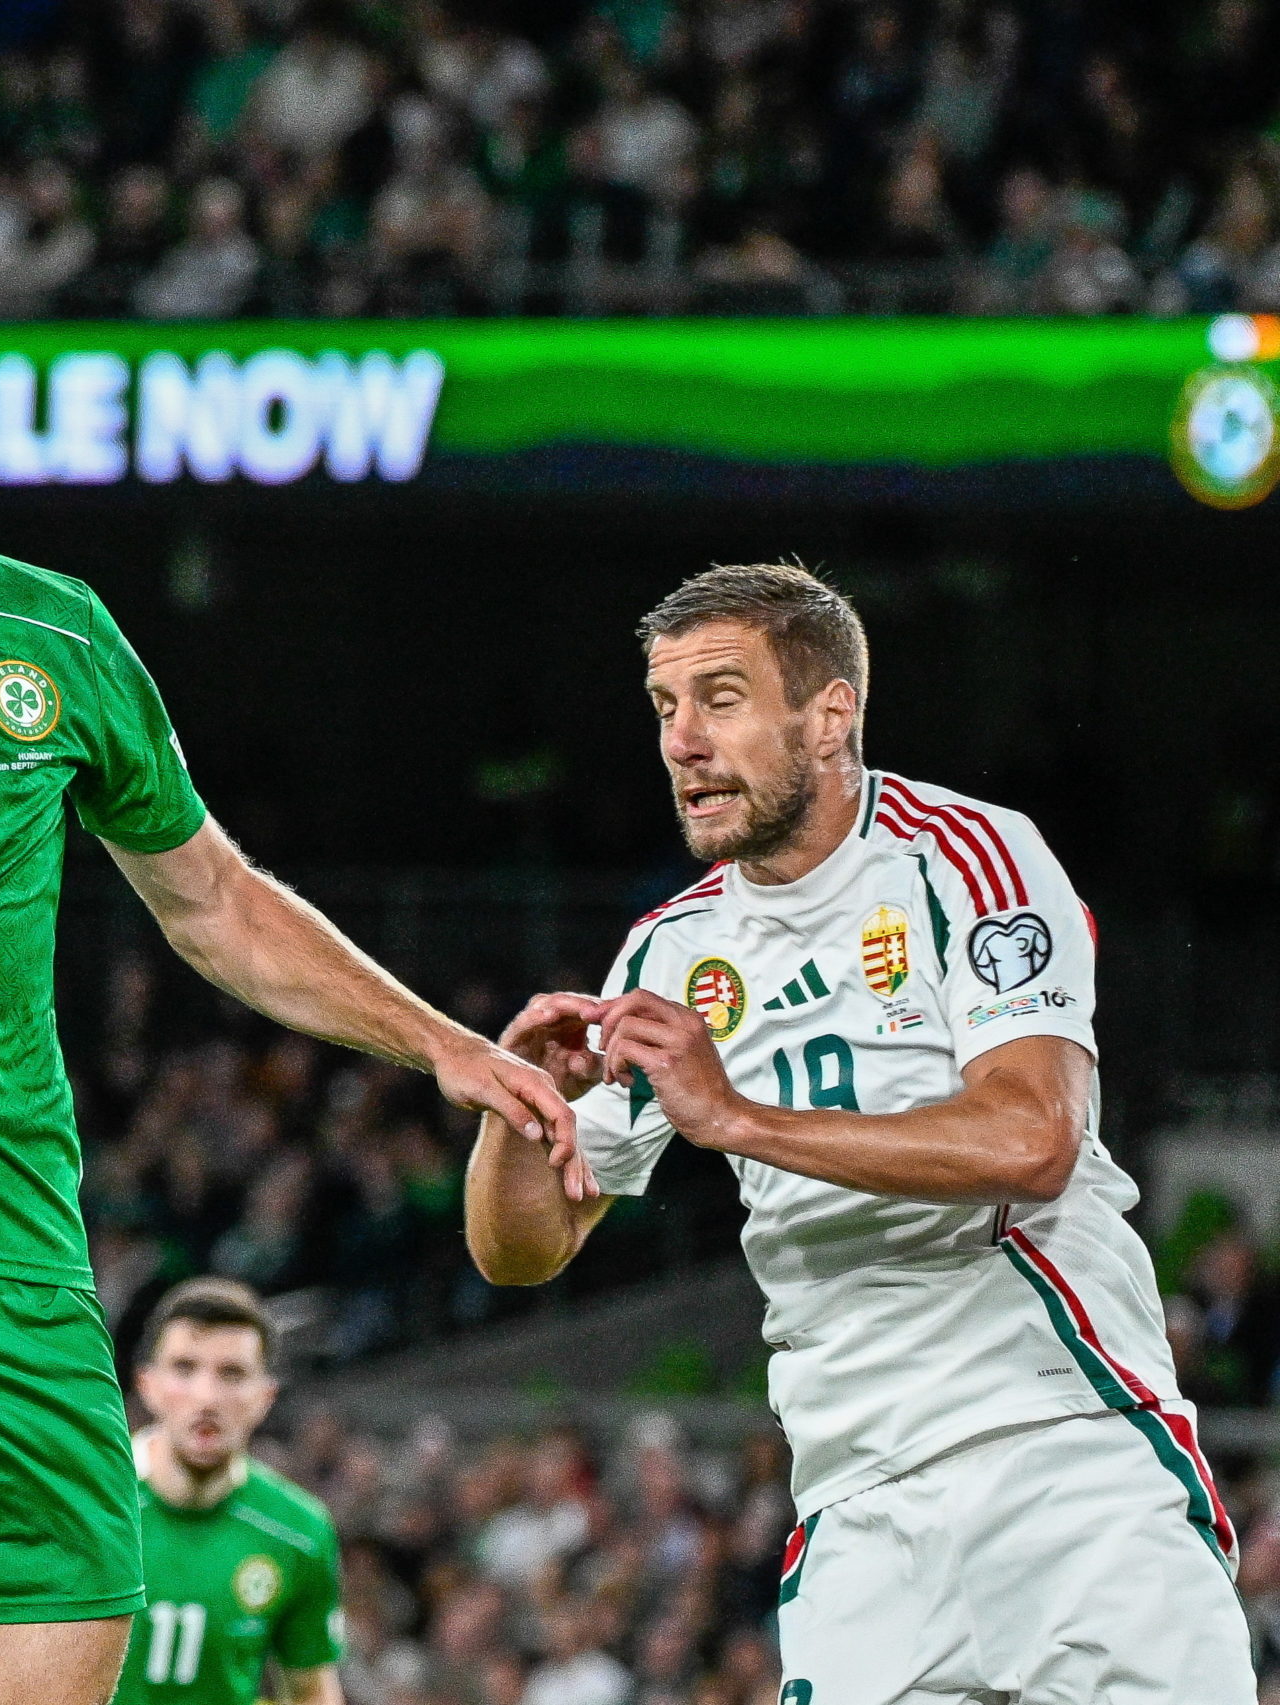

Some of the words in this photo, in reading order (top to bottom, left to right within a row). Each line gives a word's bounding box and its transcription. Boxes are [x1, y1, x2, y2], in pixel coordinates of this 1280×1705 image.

[138, 350, 444, 486] NOW
[11, 761, 37, 770] SEPTE
[17, 752, 54, 761] HUNGARY
[772, 1033, 861, 1113] 19
[145, 1601, 207, 1685] 11
